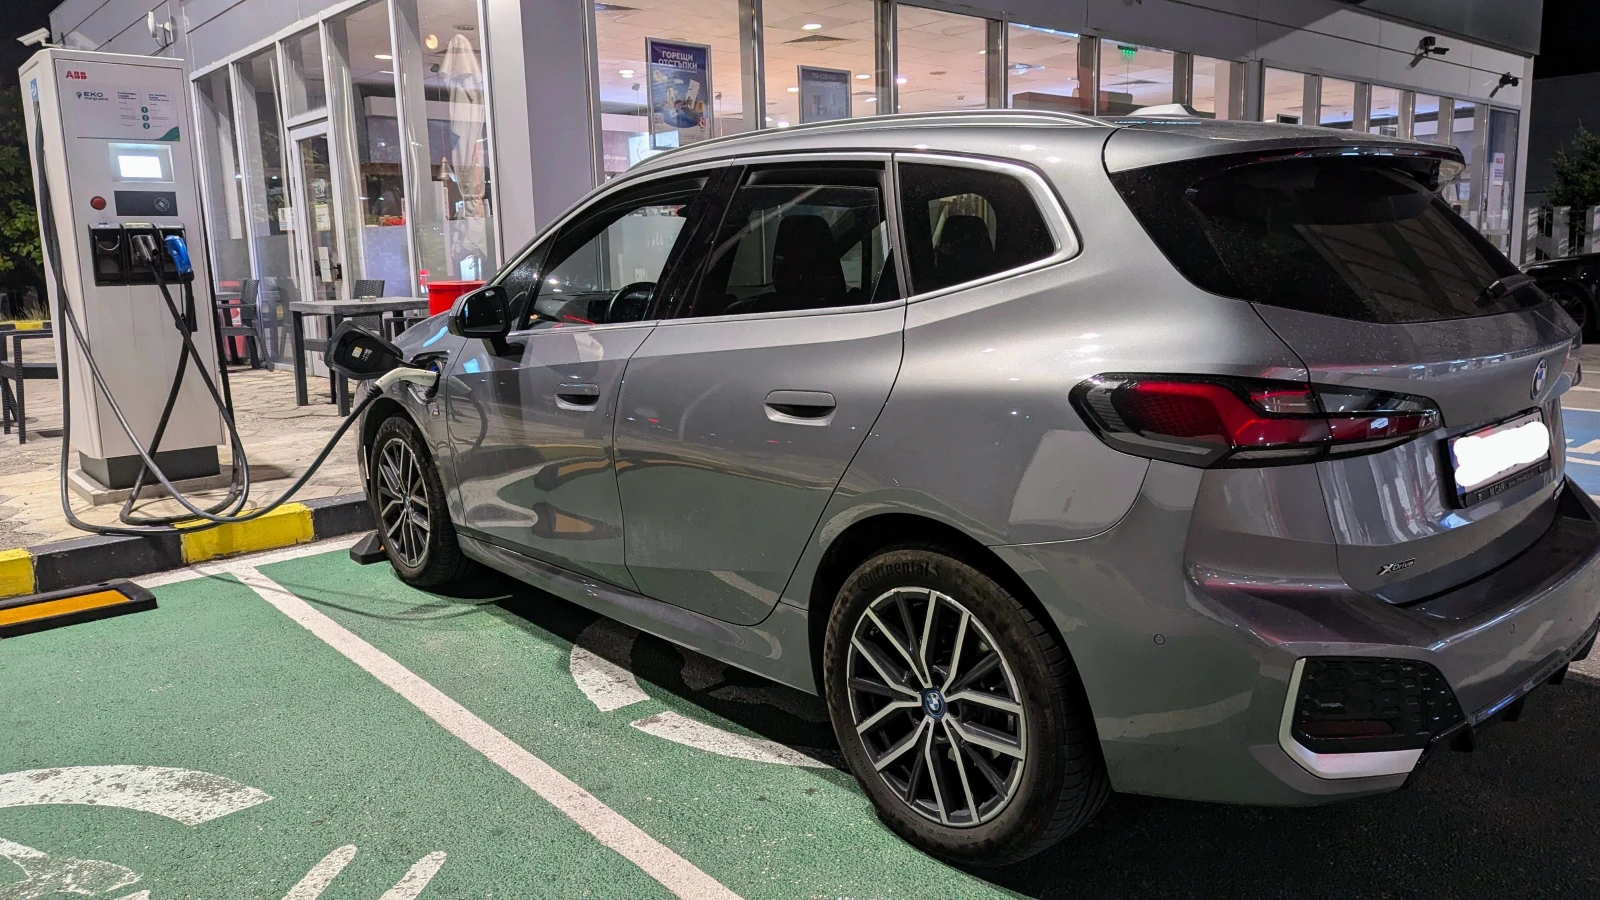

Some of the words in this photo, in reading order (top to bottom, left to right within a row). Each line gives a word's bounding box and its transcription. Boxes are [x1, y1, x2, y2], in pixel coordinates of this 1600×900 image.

[662, 50, 694, 61] ГОРЕЩИ
[658, 58, 698, 70] ОТСТЪПКИ
[66, 70, 87, 80] ABB
